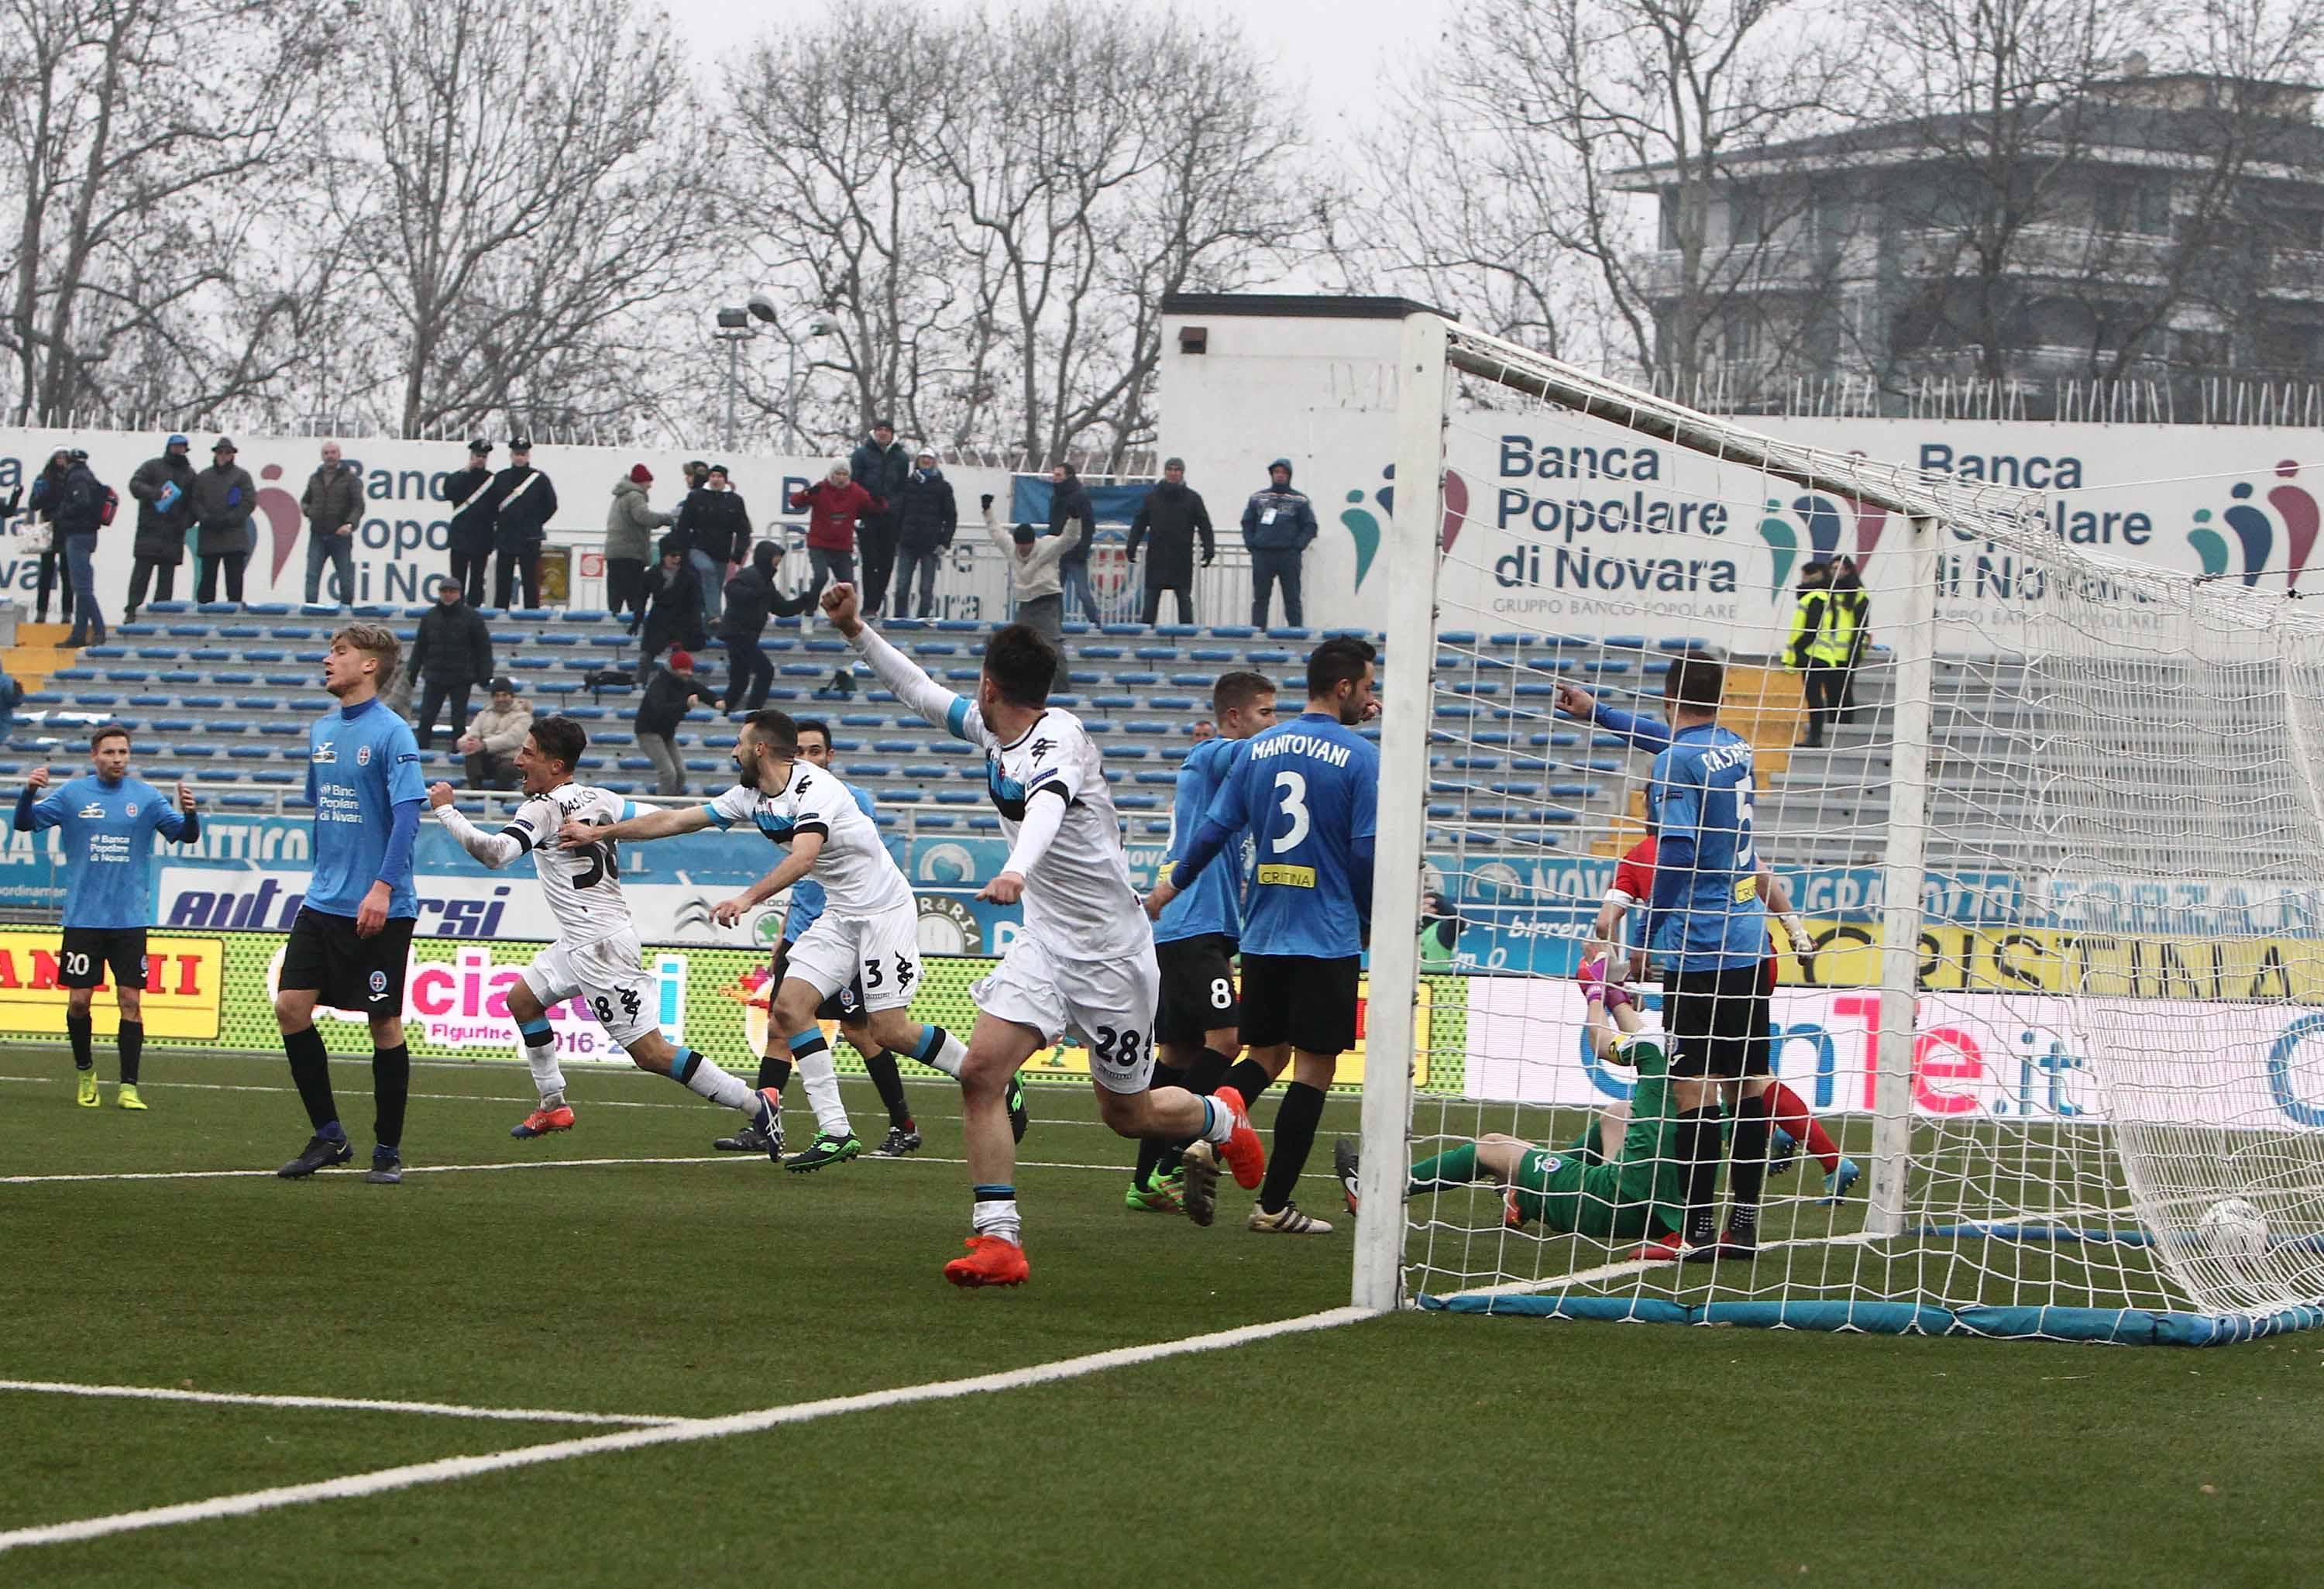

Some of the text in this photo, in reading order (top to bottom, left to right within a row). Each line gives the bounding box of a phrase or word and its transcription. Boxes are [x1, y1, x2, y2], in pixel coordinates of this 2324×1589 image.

[1500, 435, 1660, 481] Banca
[1919, 444, 2082, 490] Banca
[1497, 487, 1729, 543] Popolare
[1495, 545, 1737, 593] di Novara
[1493, 597, 1563, 615] GRUPPO
[1570, 600, 1635, 617] BANCO
[1251, 734, 1352, 768] MANTOVANI
[1272, 770, 1310, 854] 3
[66, 951, 90, 976] 20
[865, 959, 883, 989] 3
[1211, 978, 1232, 1009] 8
[431, 1023, 513, 1042] Figurine
[1095, 1026, 1141, 1068] 28
